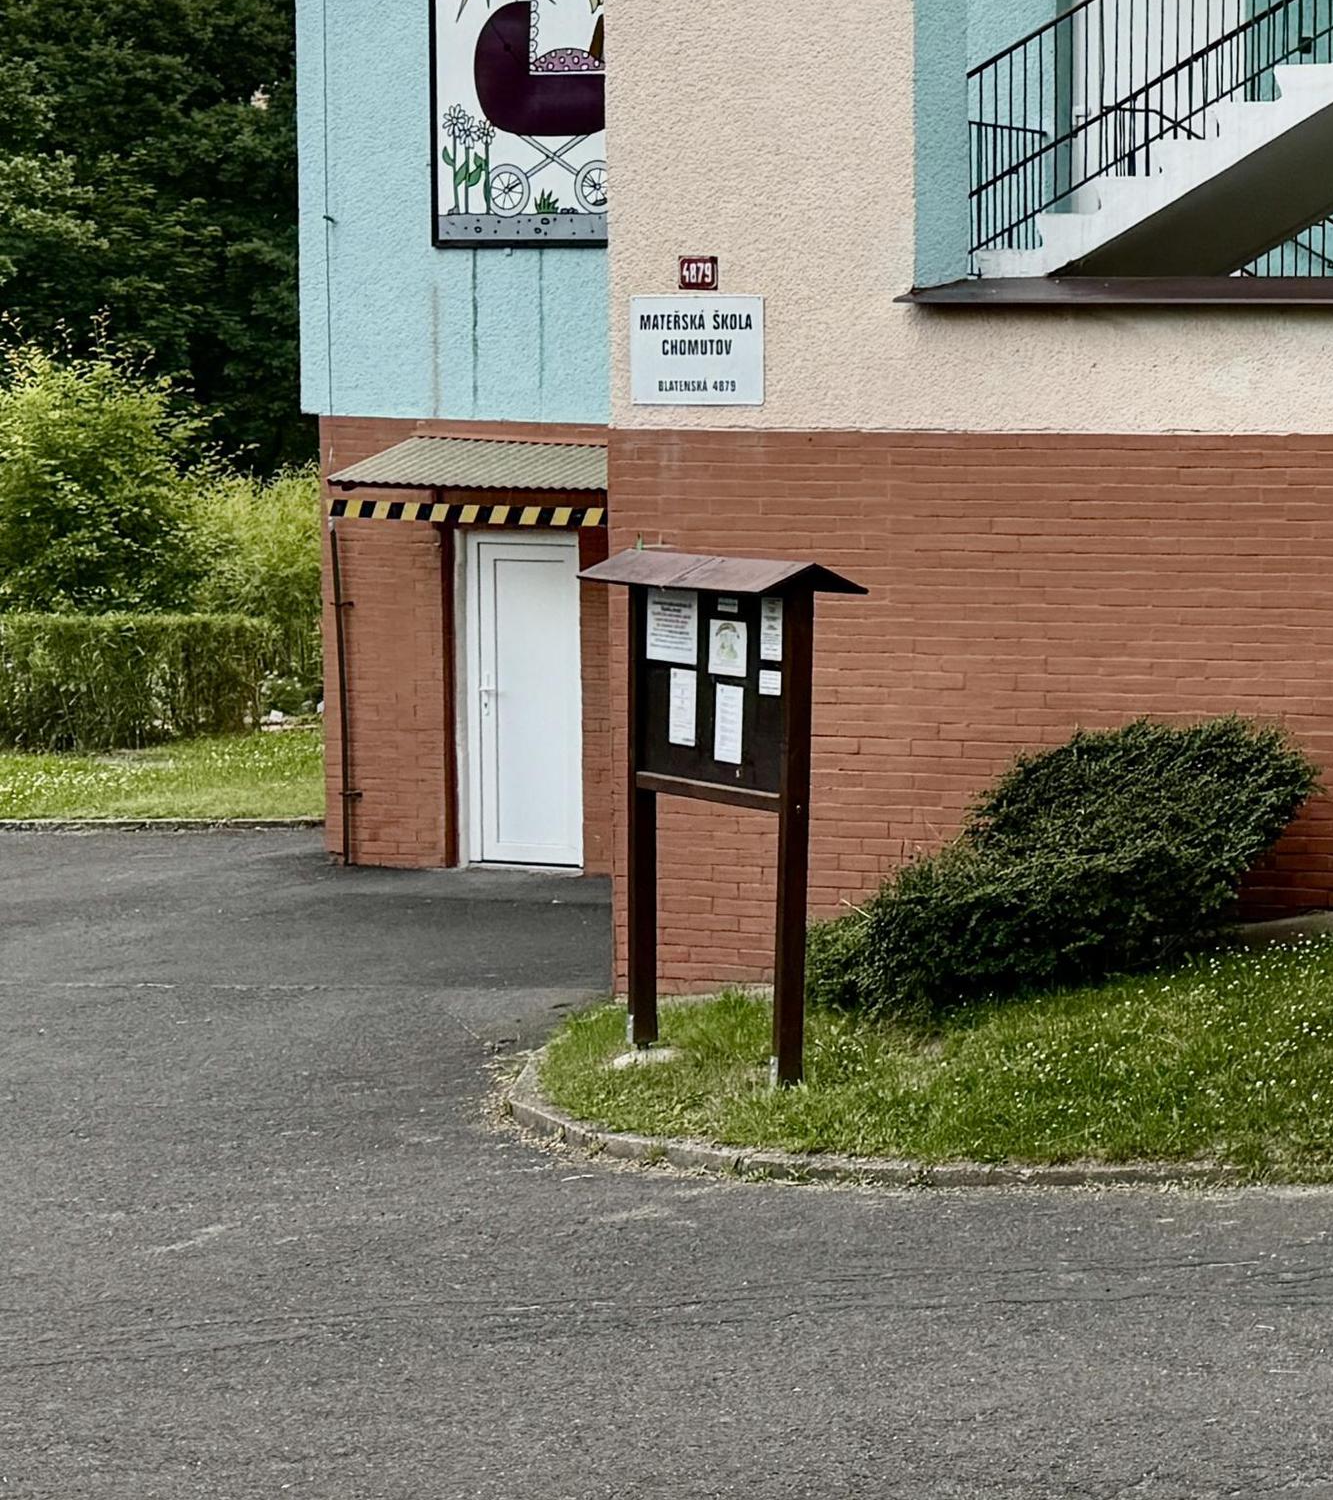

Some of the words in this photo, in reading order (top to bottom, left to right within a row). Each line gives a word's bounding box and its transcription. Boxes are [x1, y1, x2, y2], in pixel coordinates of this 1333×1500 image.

[682, 262, 713, 283] 4879
[639, 309, 706, 331] MATEŘSKÁ
[712, 309, 753, 331] ŠKOLA
[661, 339, 733, 356] CHOMUTOV
[658, 377, 708, 393] BLATENSKÁ
[712, 380, 737, 392] 4879
